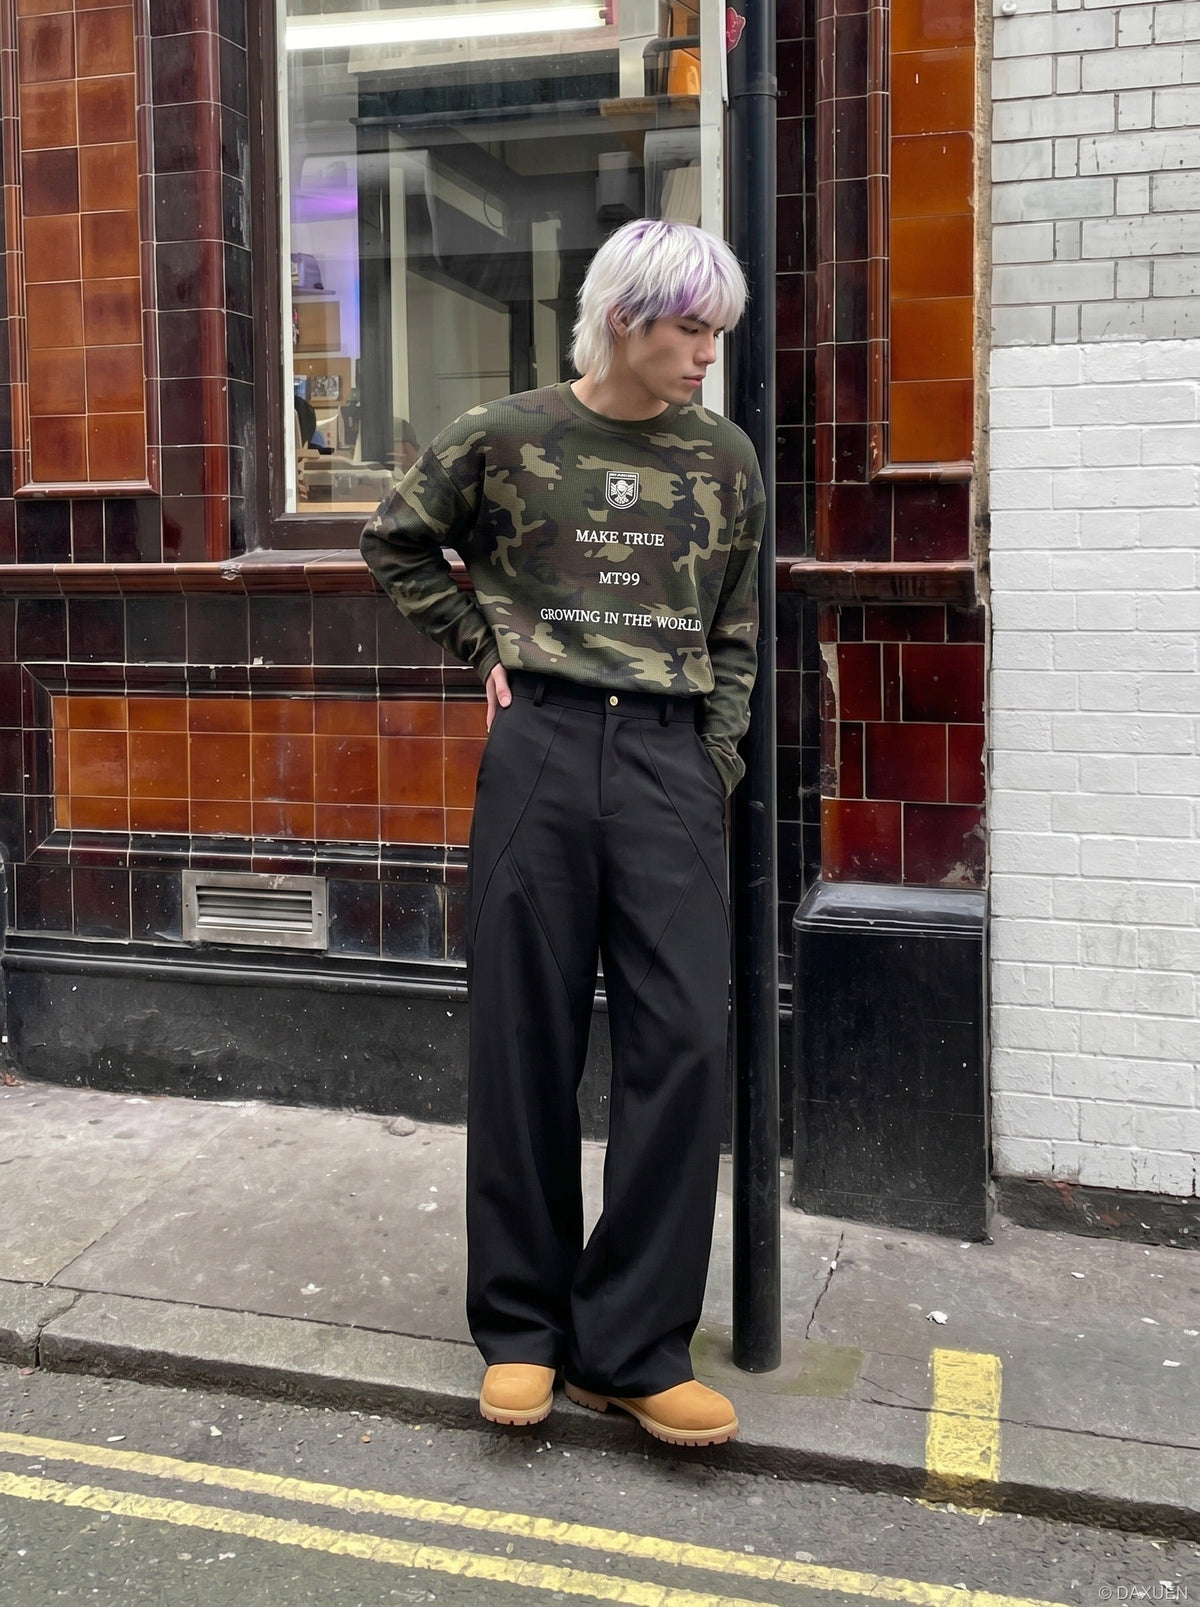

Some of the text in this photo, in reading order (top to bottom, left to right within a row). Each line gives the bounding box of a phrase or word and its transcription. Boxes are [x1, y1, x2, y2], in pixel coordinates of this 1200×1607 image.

[575, 529, 664, 546] MAKE TRUE
[598, 571, 640, 586] MT99
[540, 608, 702, 631] GROWING IN THE WORLD
